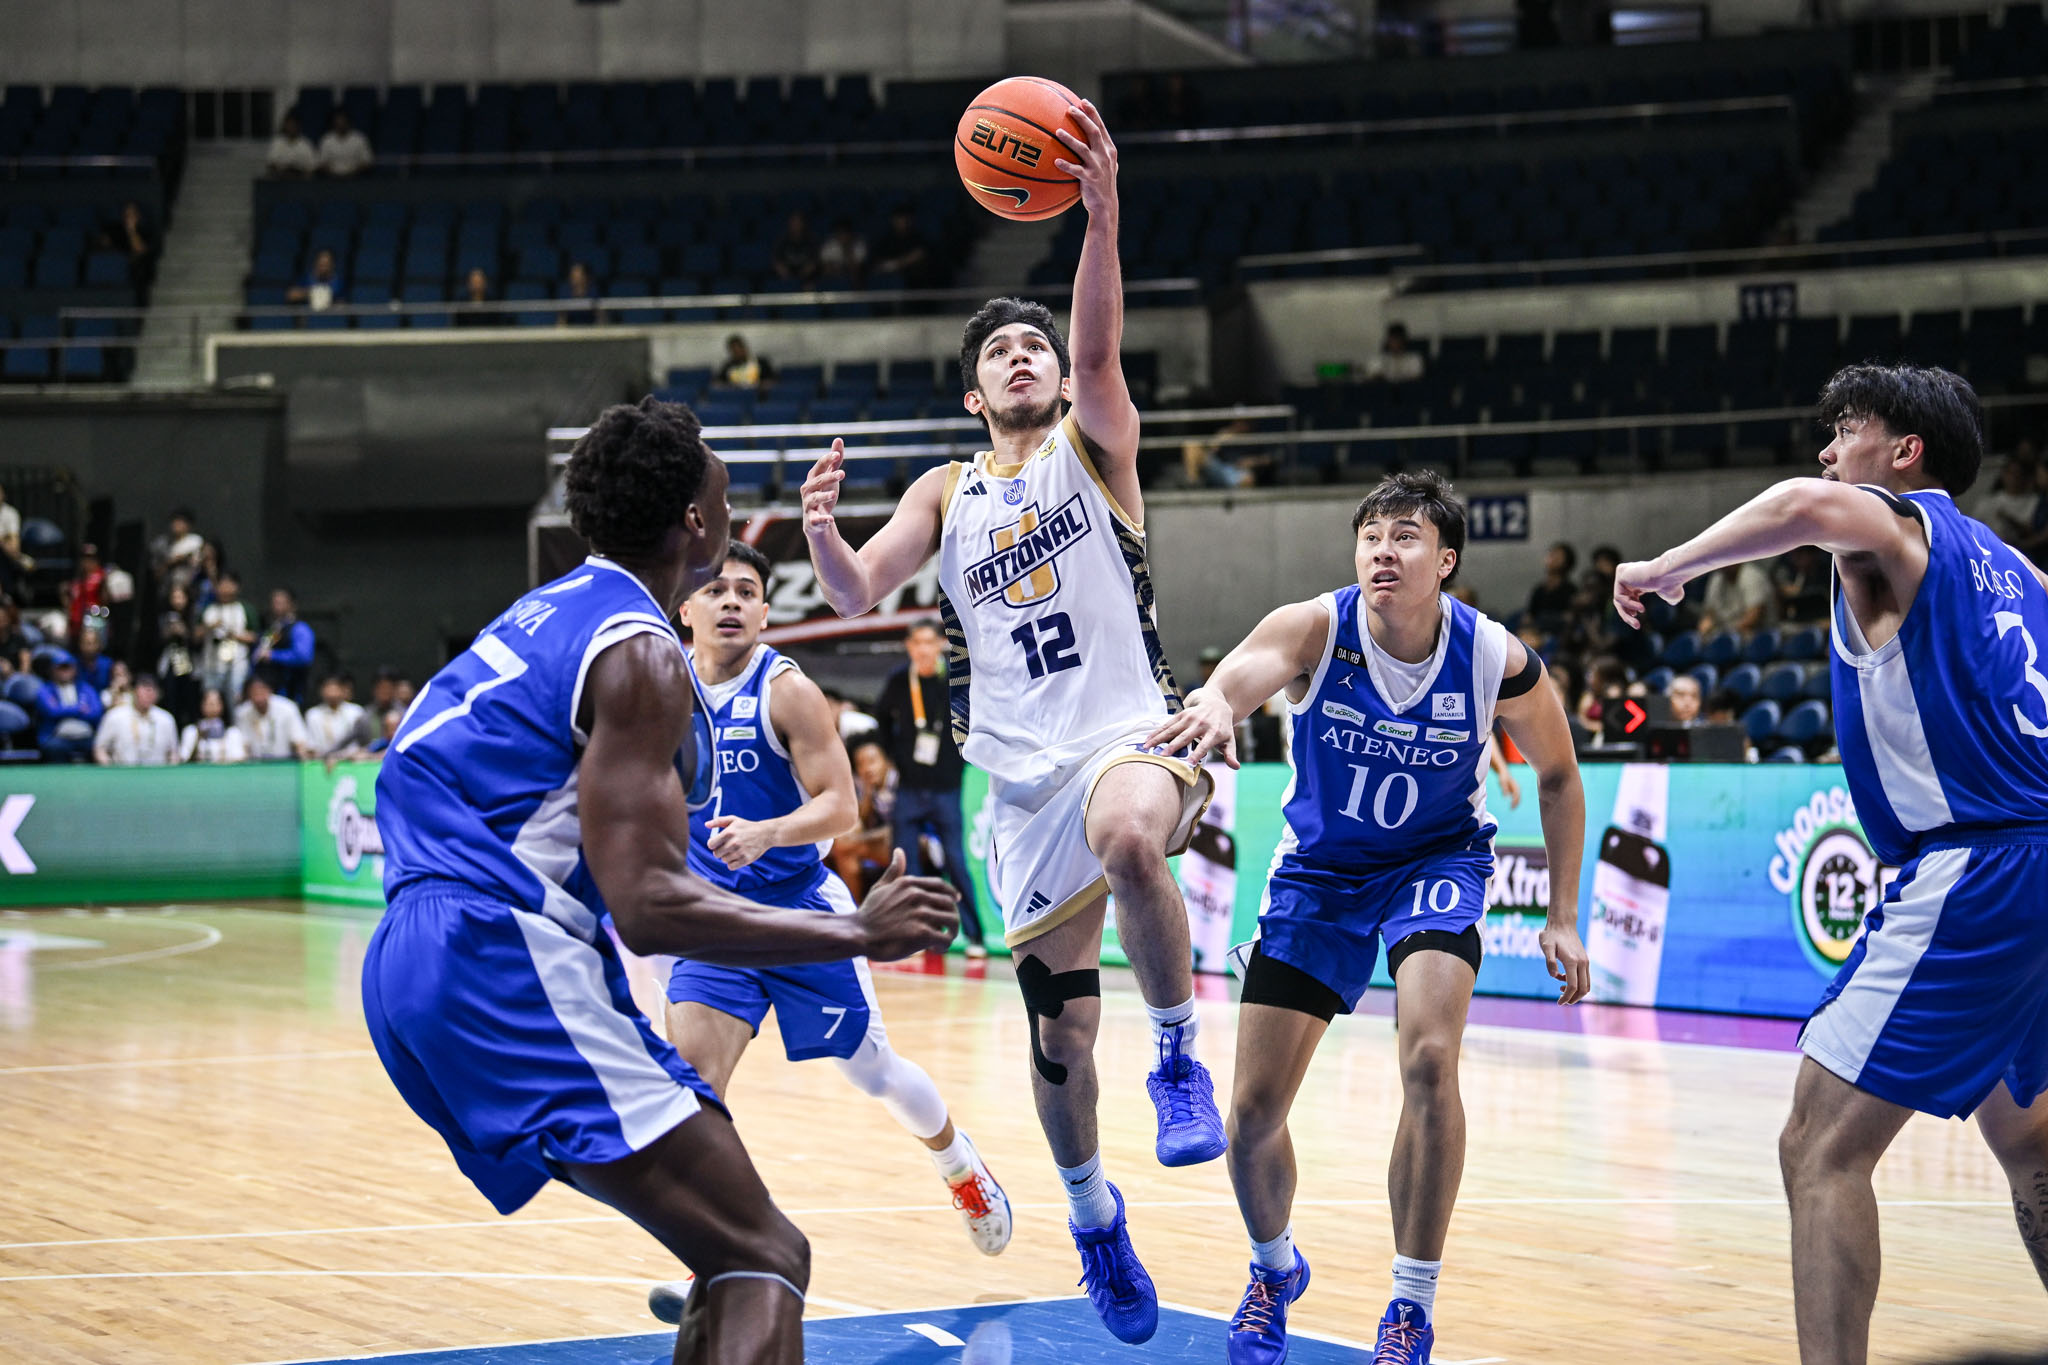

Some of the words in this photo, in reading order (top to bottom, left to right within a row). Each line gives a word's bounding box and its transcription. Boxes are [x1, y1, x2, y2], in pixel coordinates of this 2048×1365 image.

[970, 122, 1042, 169] ELITE
[1471, 501, 1524, 535] 112
[967, 508, 1084, 600] NATIONAL
[1010, 612, 1082, 679] 12
[1994, 611, 2048, 739] 3
[1319, 725, 1459, 767] ATENEO
[1388, 726, 1413, 738] Smart
[1338, 763, 1419, 830] 10
[1410, 879, 1460, 917] 10
[1825, 872, 1856, 908] 12
[822, 1006, 847, 1039] 7
